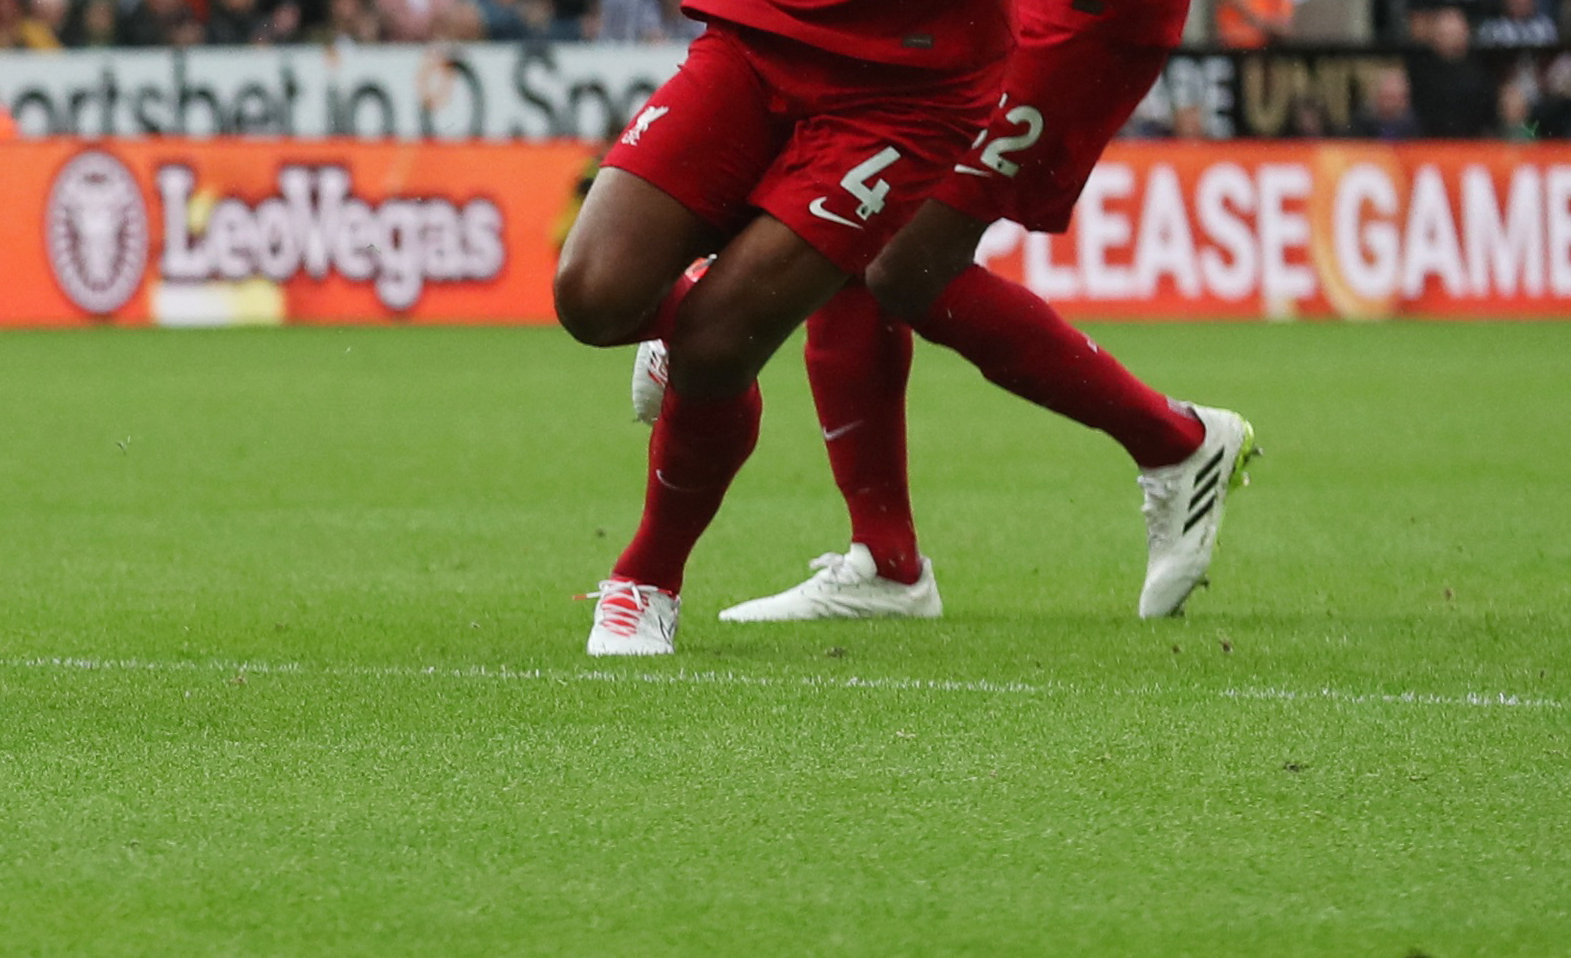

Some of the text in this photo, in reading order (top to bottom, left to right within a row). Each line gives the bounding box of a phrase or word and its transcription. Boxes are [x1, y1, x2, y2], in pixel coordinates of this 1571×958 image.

[971, 92, 1044, 178] 2
[840, 146, 901, 221] 4
[154, 162, 506, 311] LeoVegas
